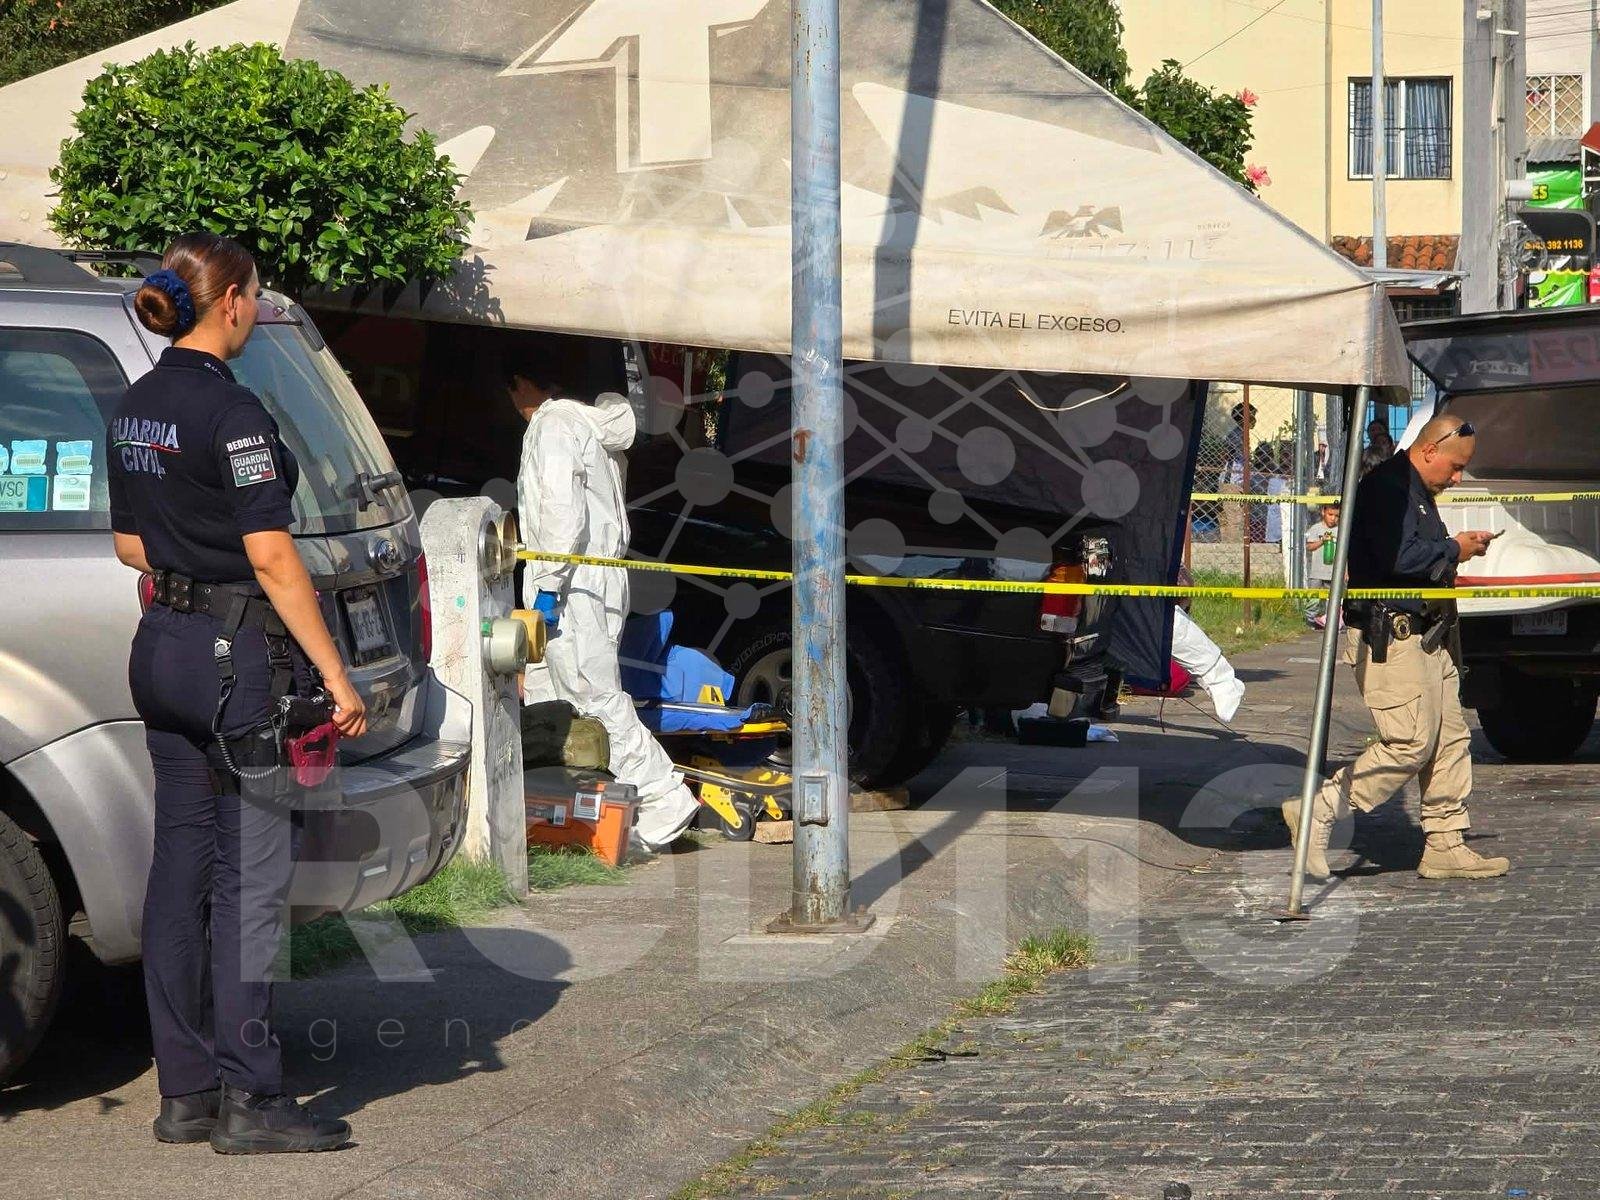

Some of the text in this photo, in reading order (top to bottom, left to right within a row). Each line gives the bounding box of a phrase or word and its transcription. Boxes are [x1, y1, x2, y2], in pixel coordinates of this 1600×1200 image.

[948, 309, 1126, 333] EVITA EL EXCESO.
[226, 435, 265, 451] BEDOLLA
[234, 452, 270, 468] GUARDIA
[238, 464, 270, 476] CIVIL
[710, 687, 720, 702] A
